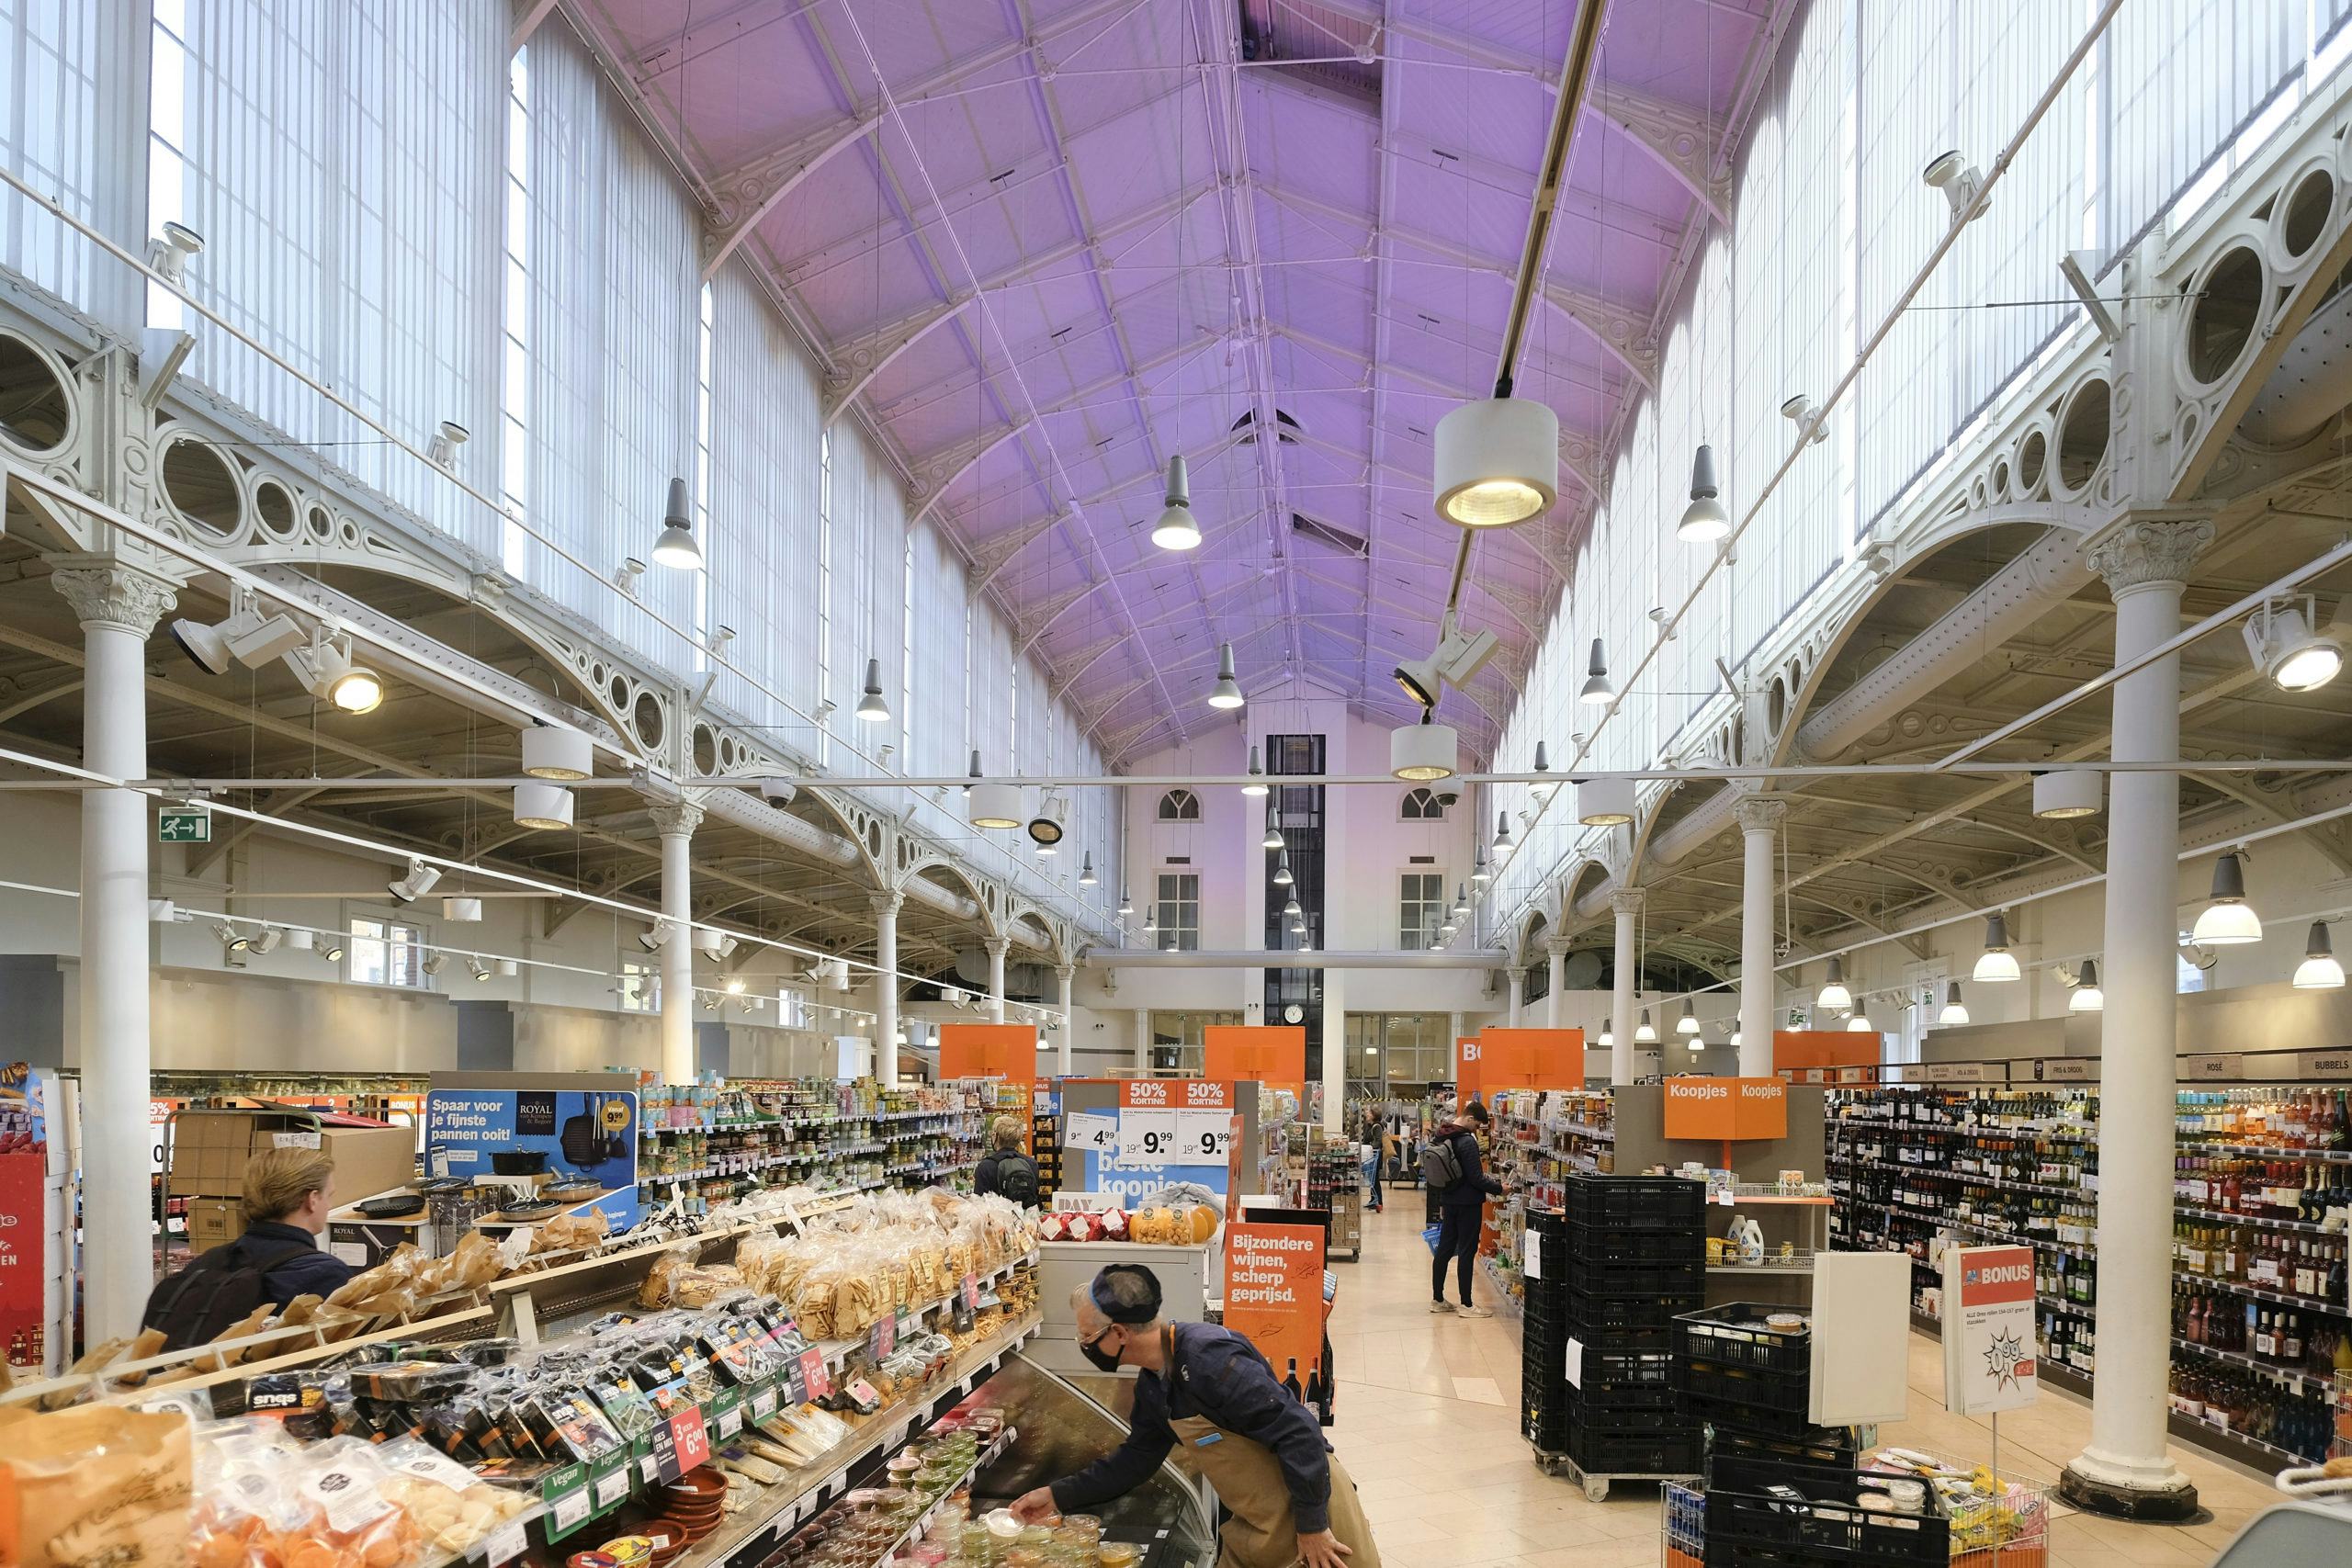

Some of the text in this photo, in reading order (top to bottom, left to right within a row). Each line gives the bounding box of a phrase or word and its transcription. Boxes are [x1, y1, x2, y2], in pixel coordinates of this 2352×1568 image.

[2207, 1062, 2222, 1071] ROSÉ
[2315, 1060, 2348, 1070] BUBBELS
[1130, 1082, 1167, 1098] 50%
[1187, 1083, 1225, 1098] 50%
[1670, 1084, 1727, 1100] Koopjes
[1742, 1084, 1781, 1099] Koopjes
[390, 1100, 416, 1110] BONUS
[432, 1099, 470, 1113] Spaar
[473, 1101, 503, 1111] voor
[520, 1104, 553, 1114] ROYAL
[430, 1113, 487, 1128] je fijnste
[607, 1112, 623, 1122] 9.99
[431, 1128, 511, 1142] pannen ooit!
[1093, 1130, 1114, 1145] 4.99
[1144, 1132, 1172, 1154] 9.99
[1201, 1133, 1229, 1155] 9.99
[1098, 1174, 1192, 1201] koopj
[1233, 1234, 1314, 1251] Bijzondere
[1232, 1251, 1288, 1270] wijnen,
[1232, 1269, 1284, 1287] scherp
[1982, 1264, 2030, 1284] BONUS
[1231, 1286, 1296, 1304] geprijsd.
[803, 1360, 809, 1375] 3
[653, 1431, 666, 1443] KIES
[675, 1424, 684, 1441] 3
[655, 1441, 664, 1452] EN
[685, 1428, 703, 1455] 6.00
[600, 1449, 622, 1467] Vegan
[552, 1468, 578, 1487] Vegan
